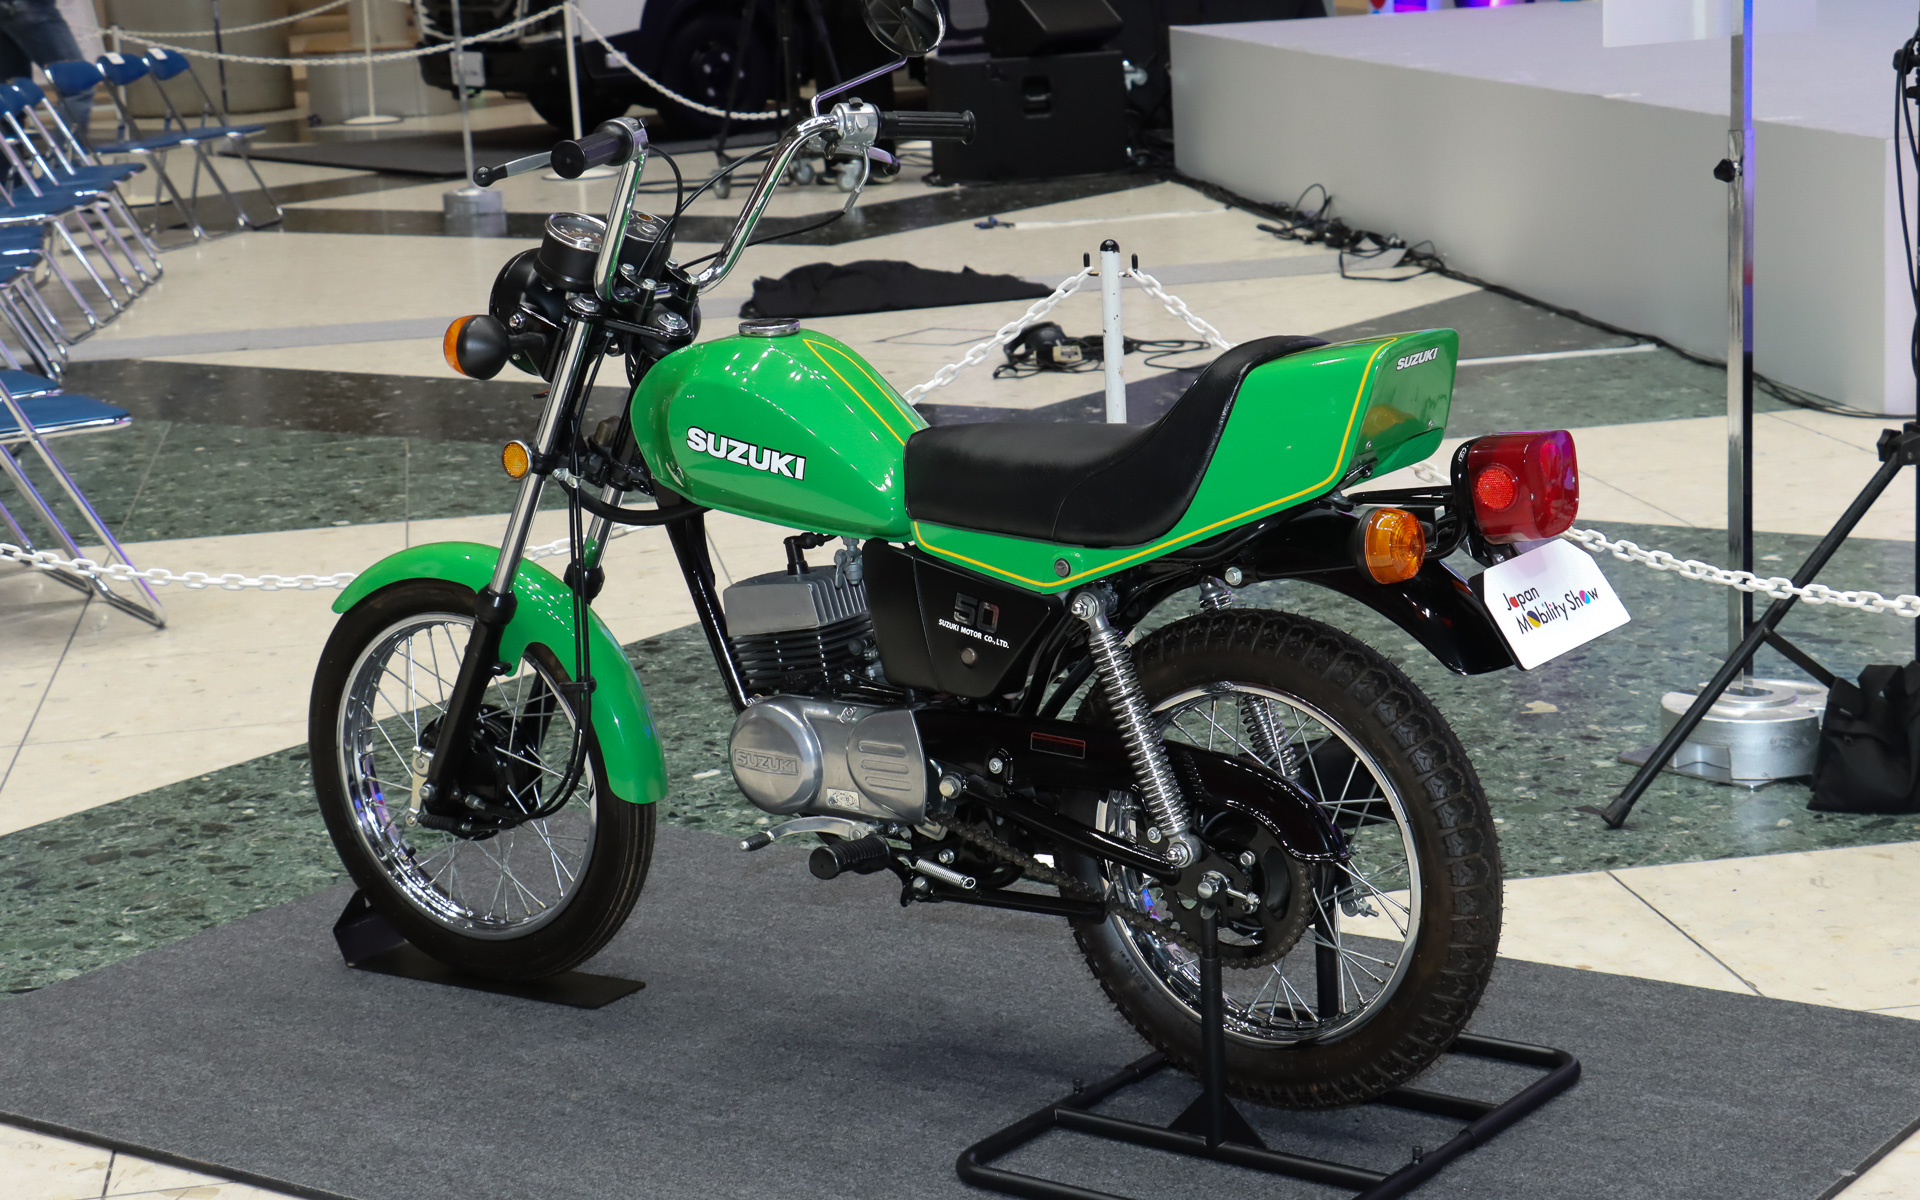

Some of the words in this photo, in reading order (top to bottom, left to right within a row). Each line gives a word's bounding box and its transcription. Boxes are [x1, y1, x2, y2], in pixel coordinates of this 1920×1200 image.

[1396, 347, 1438, 371] SUZUKI
[686, 426, 806, 481] SUZUKI
[1502, 587, 1540, 611] Japan
[1564, 587, 1599, 611] Show
[953, 592, 1000, 634] 50
[938, 618, 960, 632] SUZUKI
[960, 626, 982, 640] MOTOR
[736, 752, 797, 773] SUZUKI
